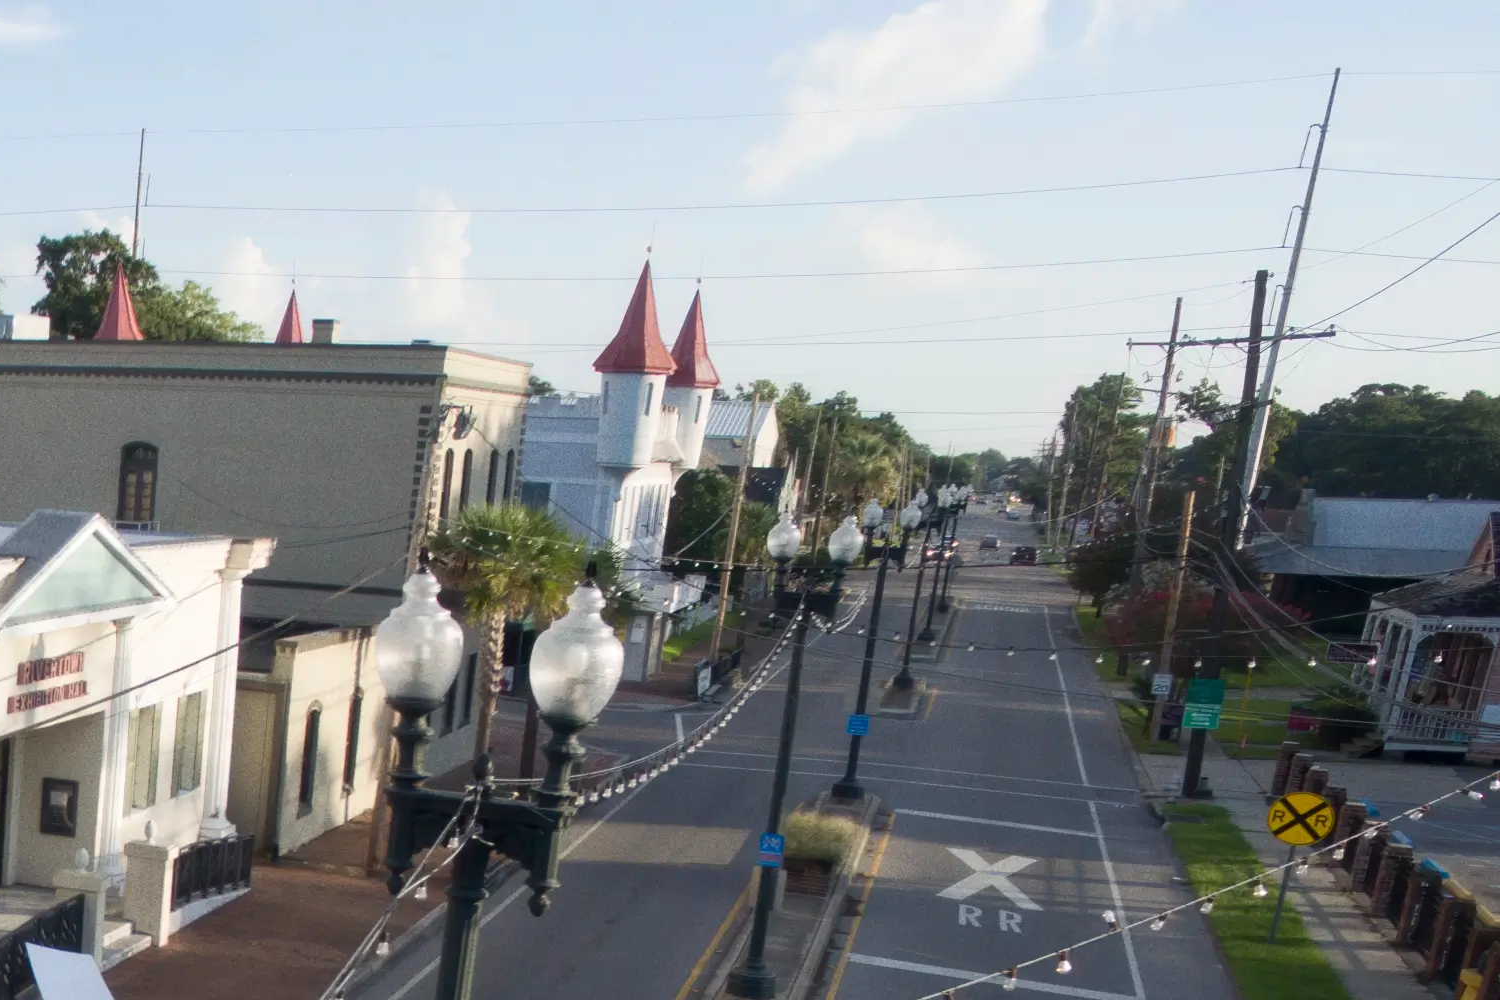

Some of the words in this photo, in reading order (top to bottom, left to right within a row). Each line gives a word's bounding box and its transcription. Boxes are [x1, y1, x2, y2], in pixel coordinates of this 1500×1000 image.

[17, 651, 84, 685] RIVERTOWN
[7, 685, 64, 714] EXHIBITION
[1153, 684, 1169, 693] 20
[1272, 809, 1285, 822] R
[1314, 814, 1328, 828] R
